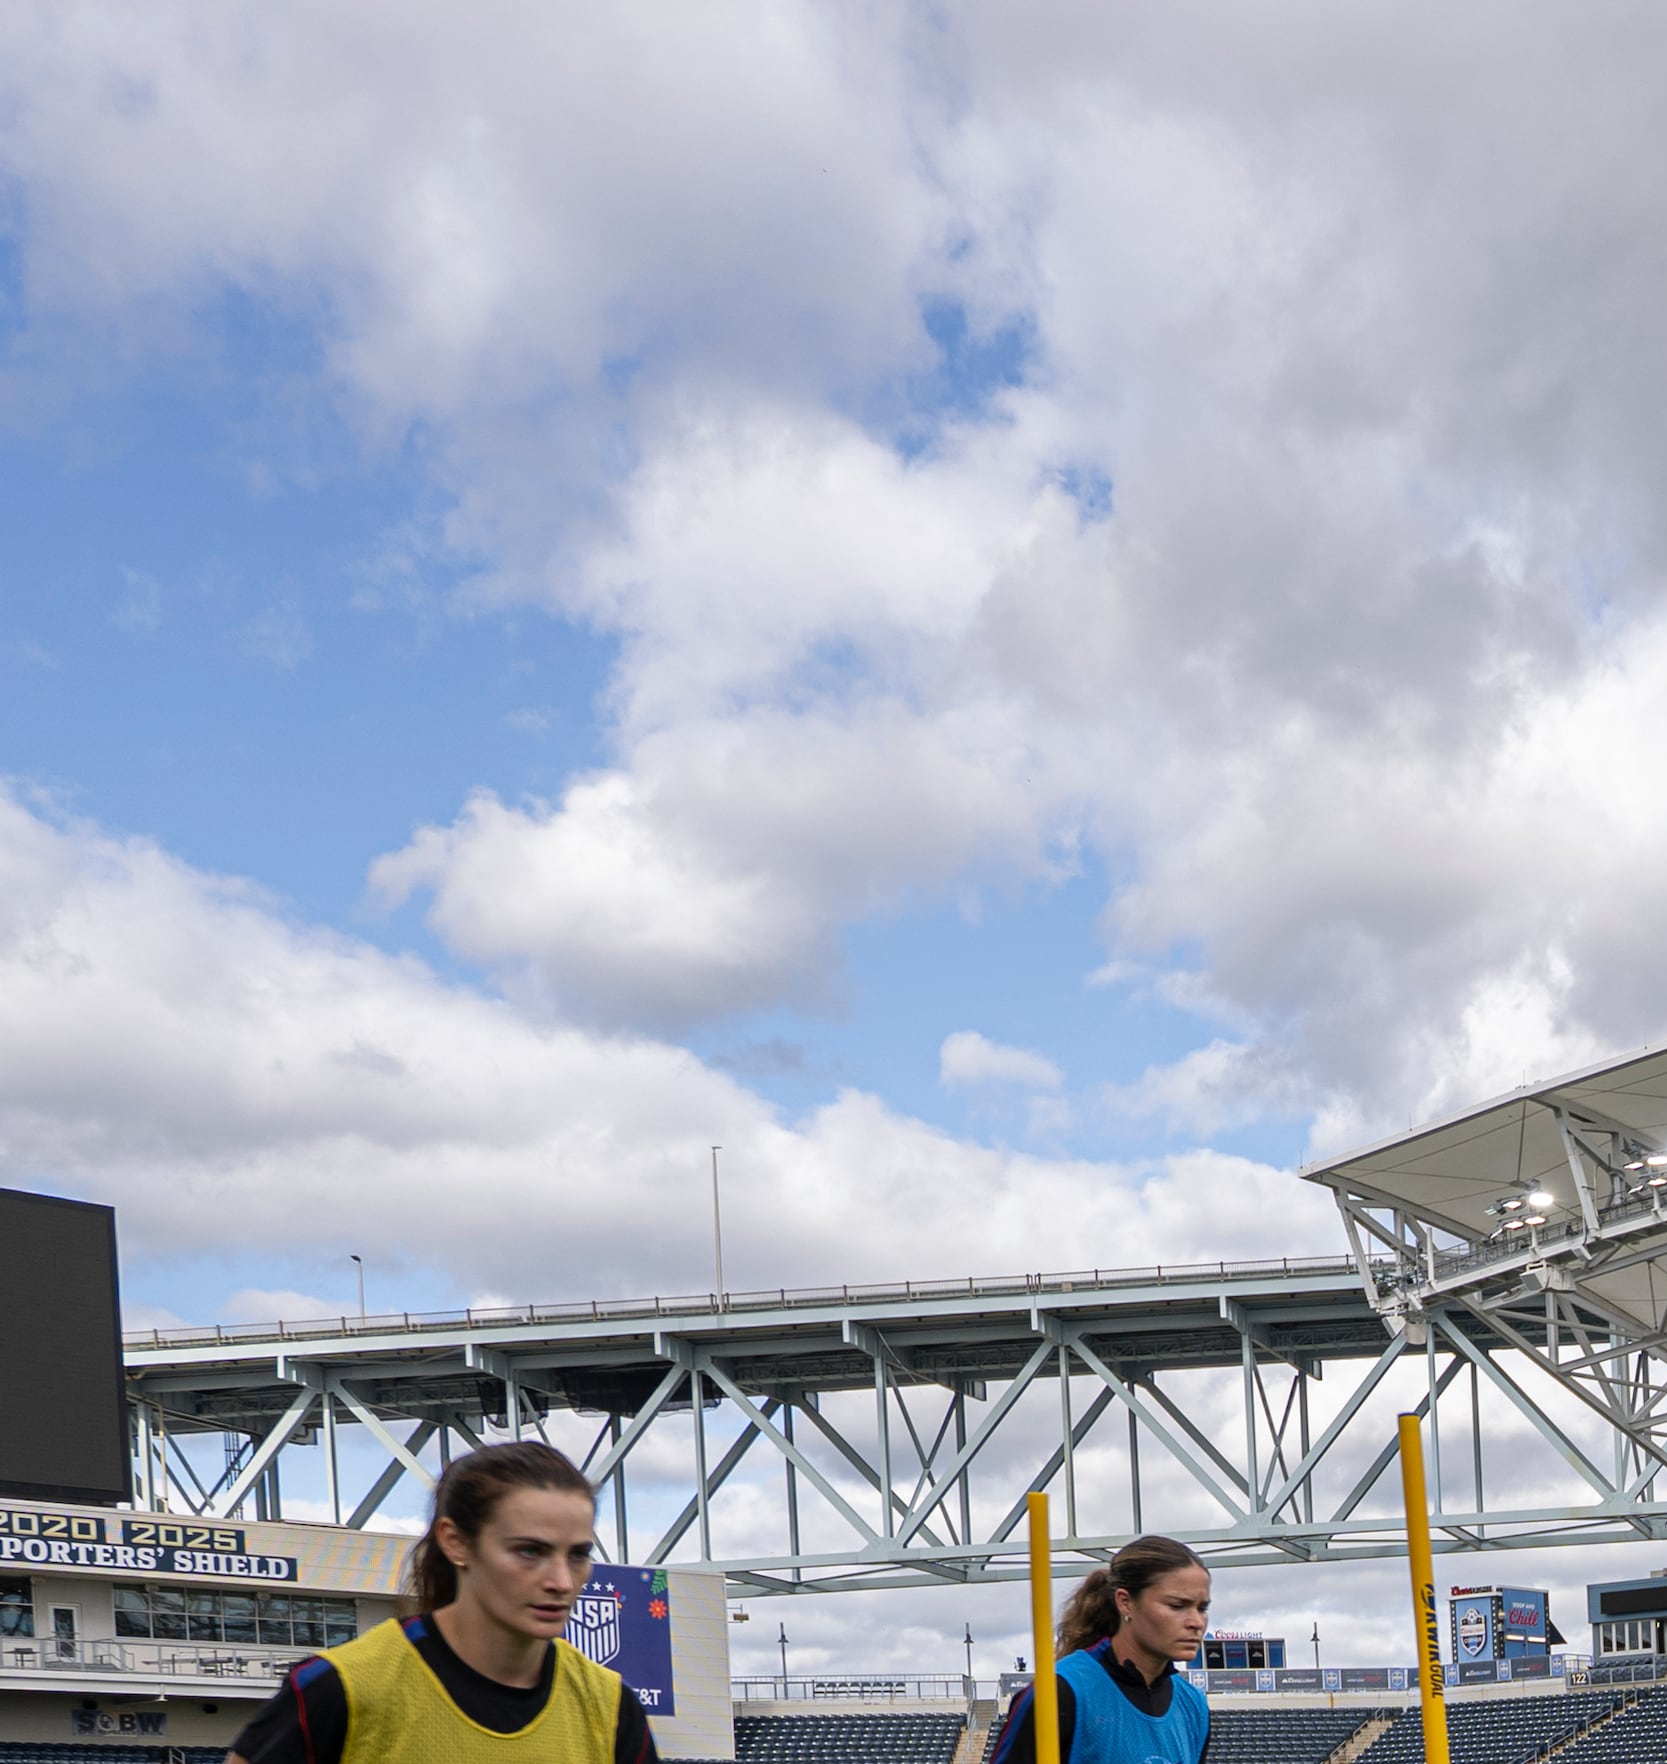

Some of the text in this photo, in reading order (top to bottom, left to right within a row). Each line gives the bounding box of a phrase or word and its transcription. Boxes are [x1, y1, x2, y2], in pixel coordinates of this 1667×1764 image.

[130, 1522, 238, 1552] 2025
[173, 1550, 290, 1579] SHIELD
[1571, 1672, 1587, 1686] 122
